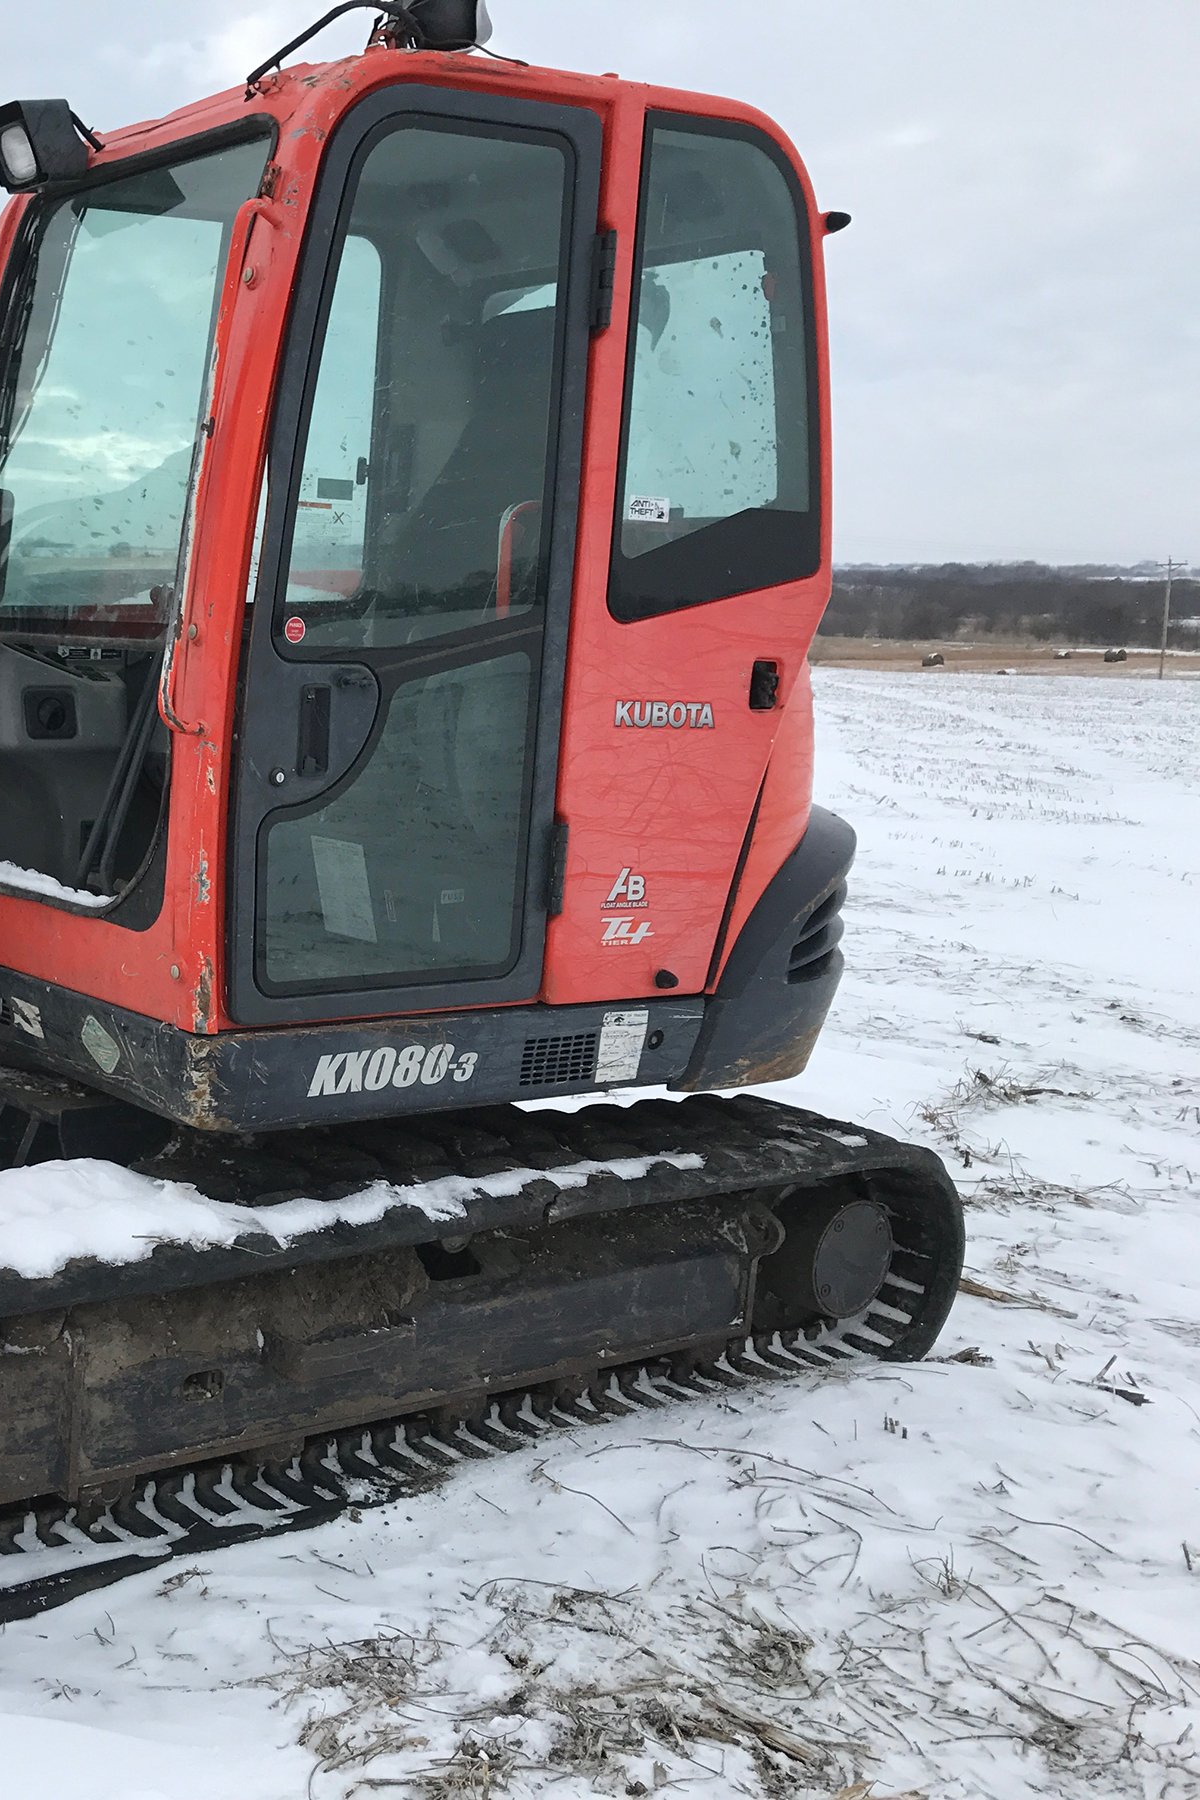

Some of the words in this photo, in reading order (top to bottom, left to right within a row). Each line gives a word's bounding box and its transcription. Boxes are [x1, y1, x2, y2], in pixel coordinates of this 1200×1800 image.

[629, 507, 654, 516] THEFT
[614, 700, 715, 728] KUBOTA
[606, 867, 645, 901] AB
[307, 1043, 479, 1098] KX080-3
